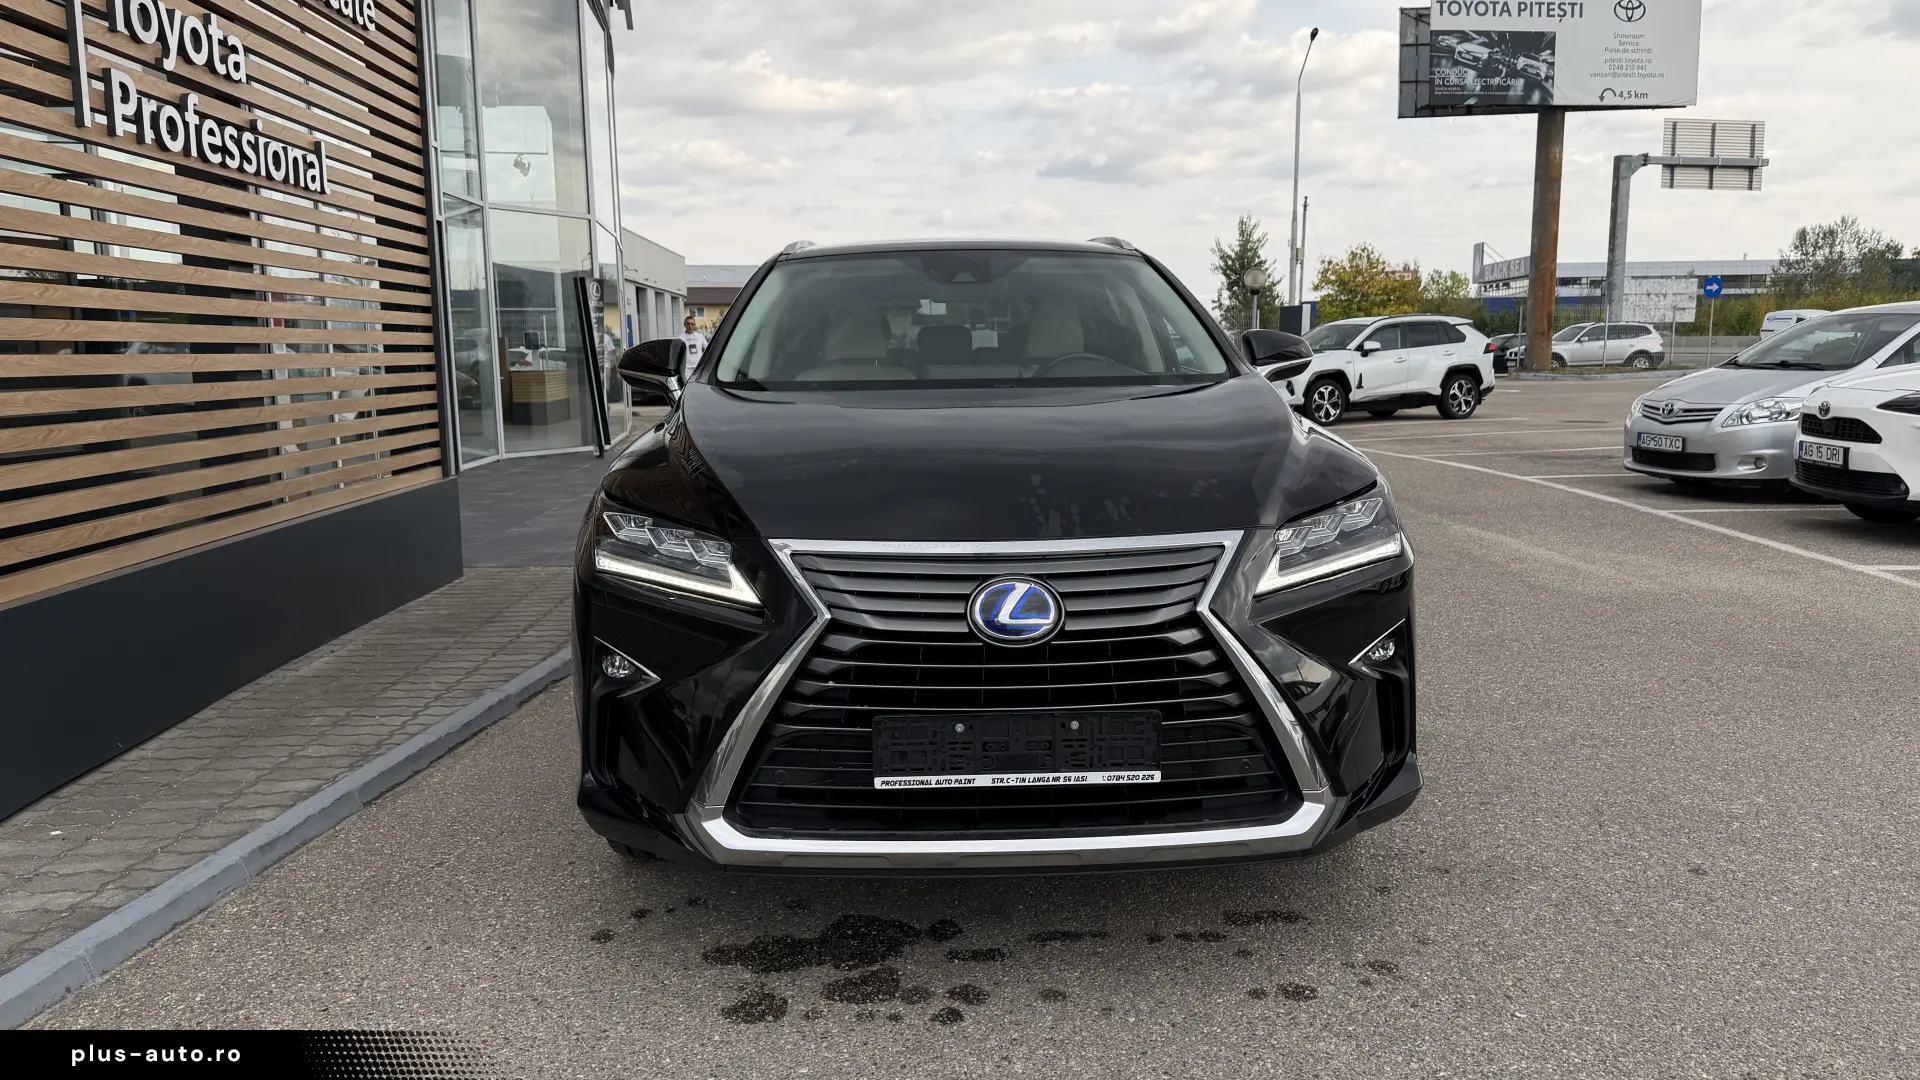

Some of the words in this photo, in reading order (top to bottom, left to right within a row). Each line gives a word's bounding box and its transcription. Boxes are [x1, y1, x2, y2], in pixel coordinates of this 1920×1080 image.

[1436, 0, 1512, 17] TOYOTA
[1517, 1, 1583, 22] PITEȘTI
[1604, 57, 1652, 65] pitesti.toyota.ro
[1434, 68, 1471, 76] CONDUC
[1618, 90, 1632, 100] 4,5
[1634, 90, 1649, 99] km
[108, 68, 331, 194] Professional
[1484, 260, 1508, 279] BLACK
[1509, 258, 1525, 275] SEA
[1641, 435, 1651, 446] AG
[1652, 436, 1663, 447] 50
[1664, 437, 1681, 449] TXC
[1803, 445, 1814, 457] AG
[1815, 446, 1823, 459] 15
[1826, 449, 1840, 462] DRI
[880, 779, 933, 787] PROFESSIONAL
[934, 778, 953, 786] AUTO
[1027, 776, 1051, 784] LANGA
[1073, 775, 1088, 783] IASI
[1140, 773, 1155, 781] 226
